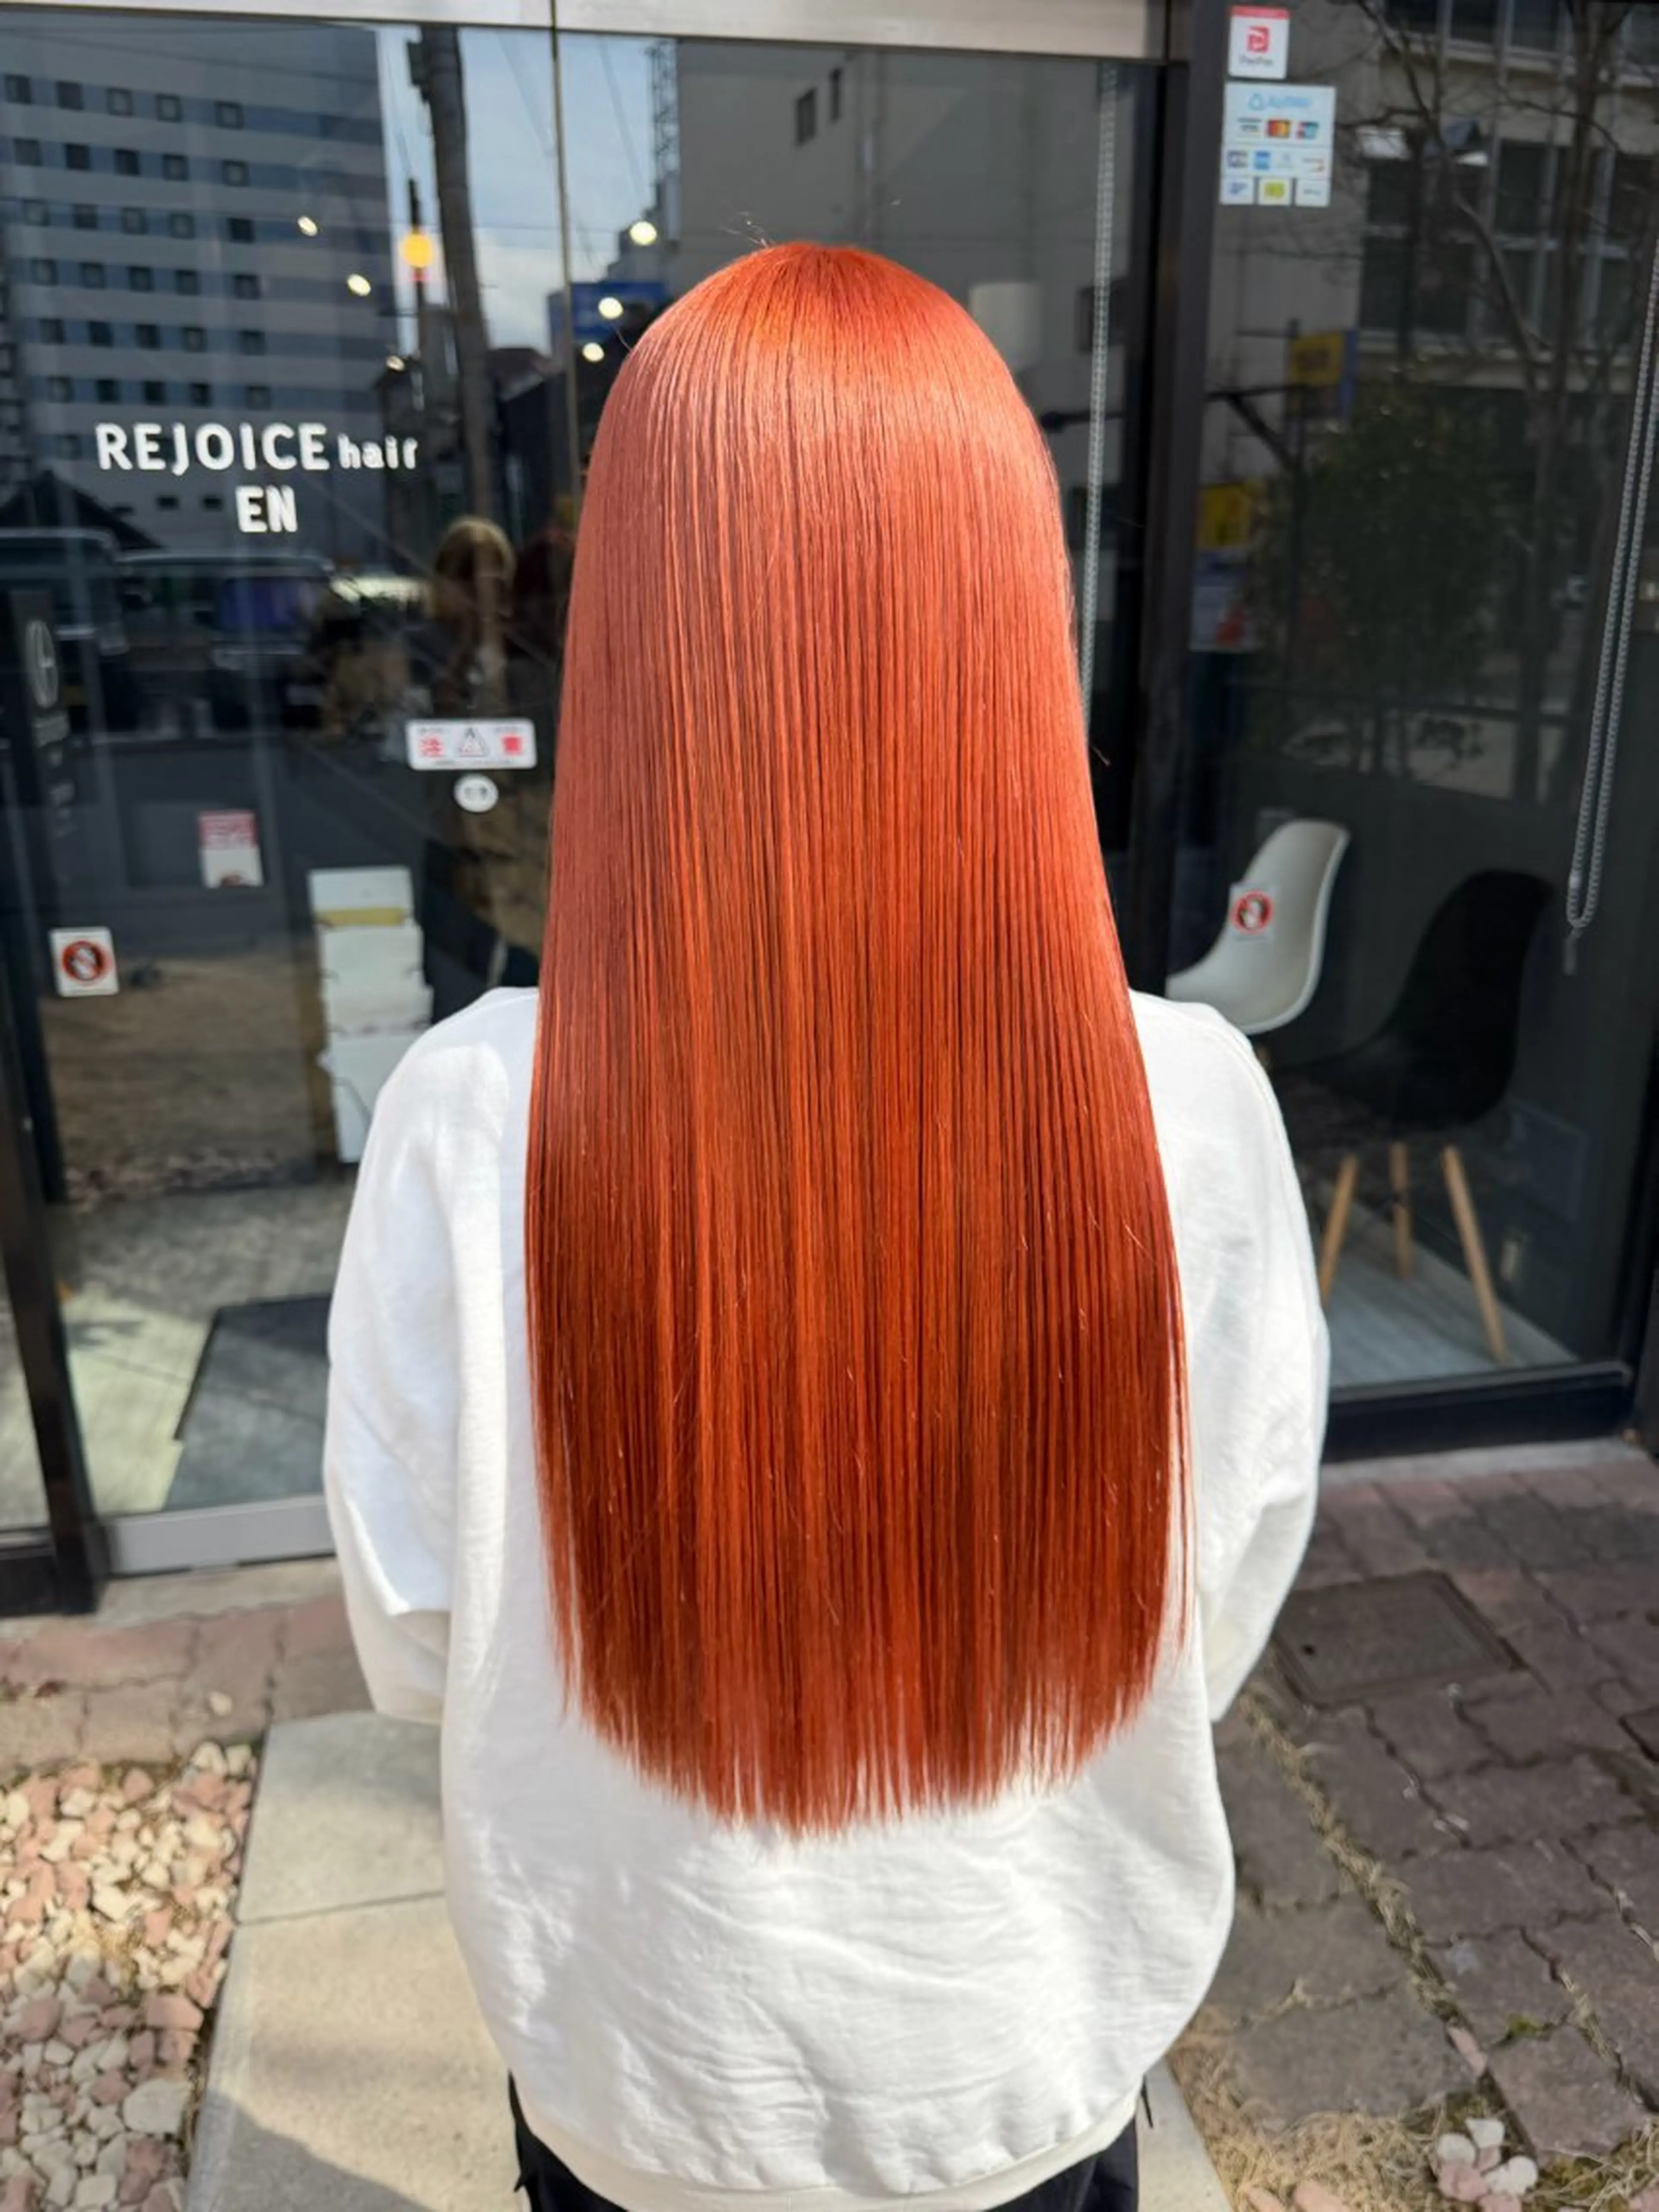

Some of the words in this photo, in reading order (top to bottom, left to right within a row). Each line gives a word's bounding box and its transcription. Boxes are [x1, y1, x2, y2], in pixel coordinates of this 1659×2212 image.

[95, 423, 330, 476] REJOICE
[337, 434, 418, 469] hair
[235, 485, 298, 532] EN
